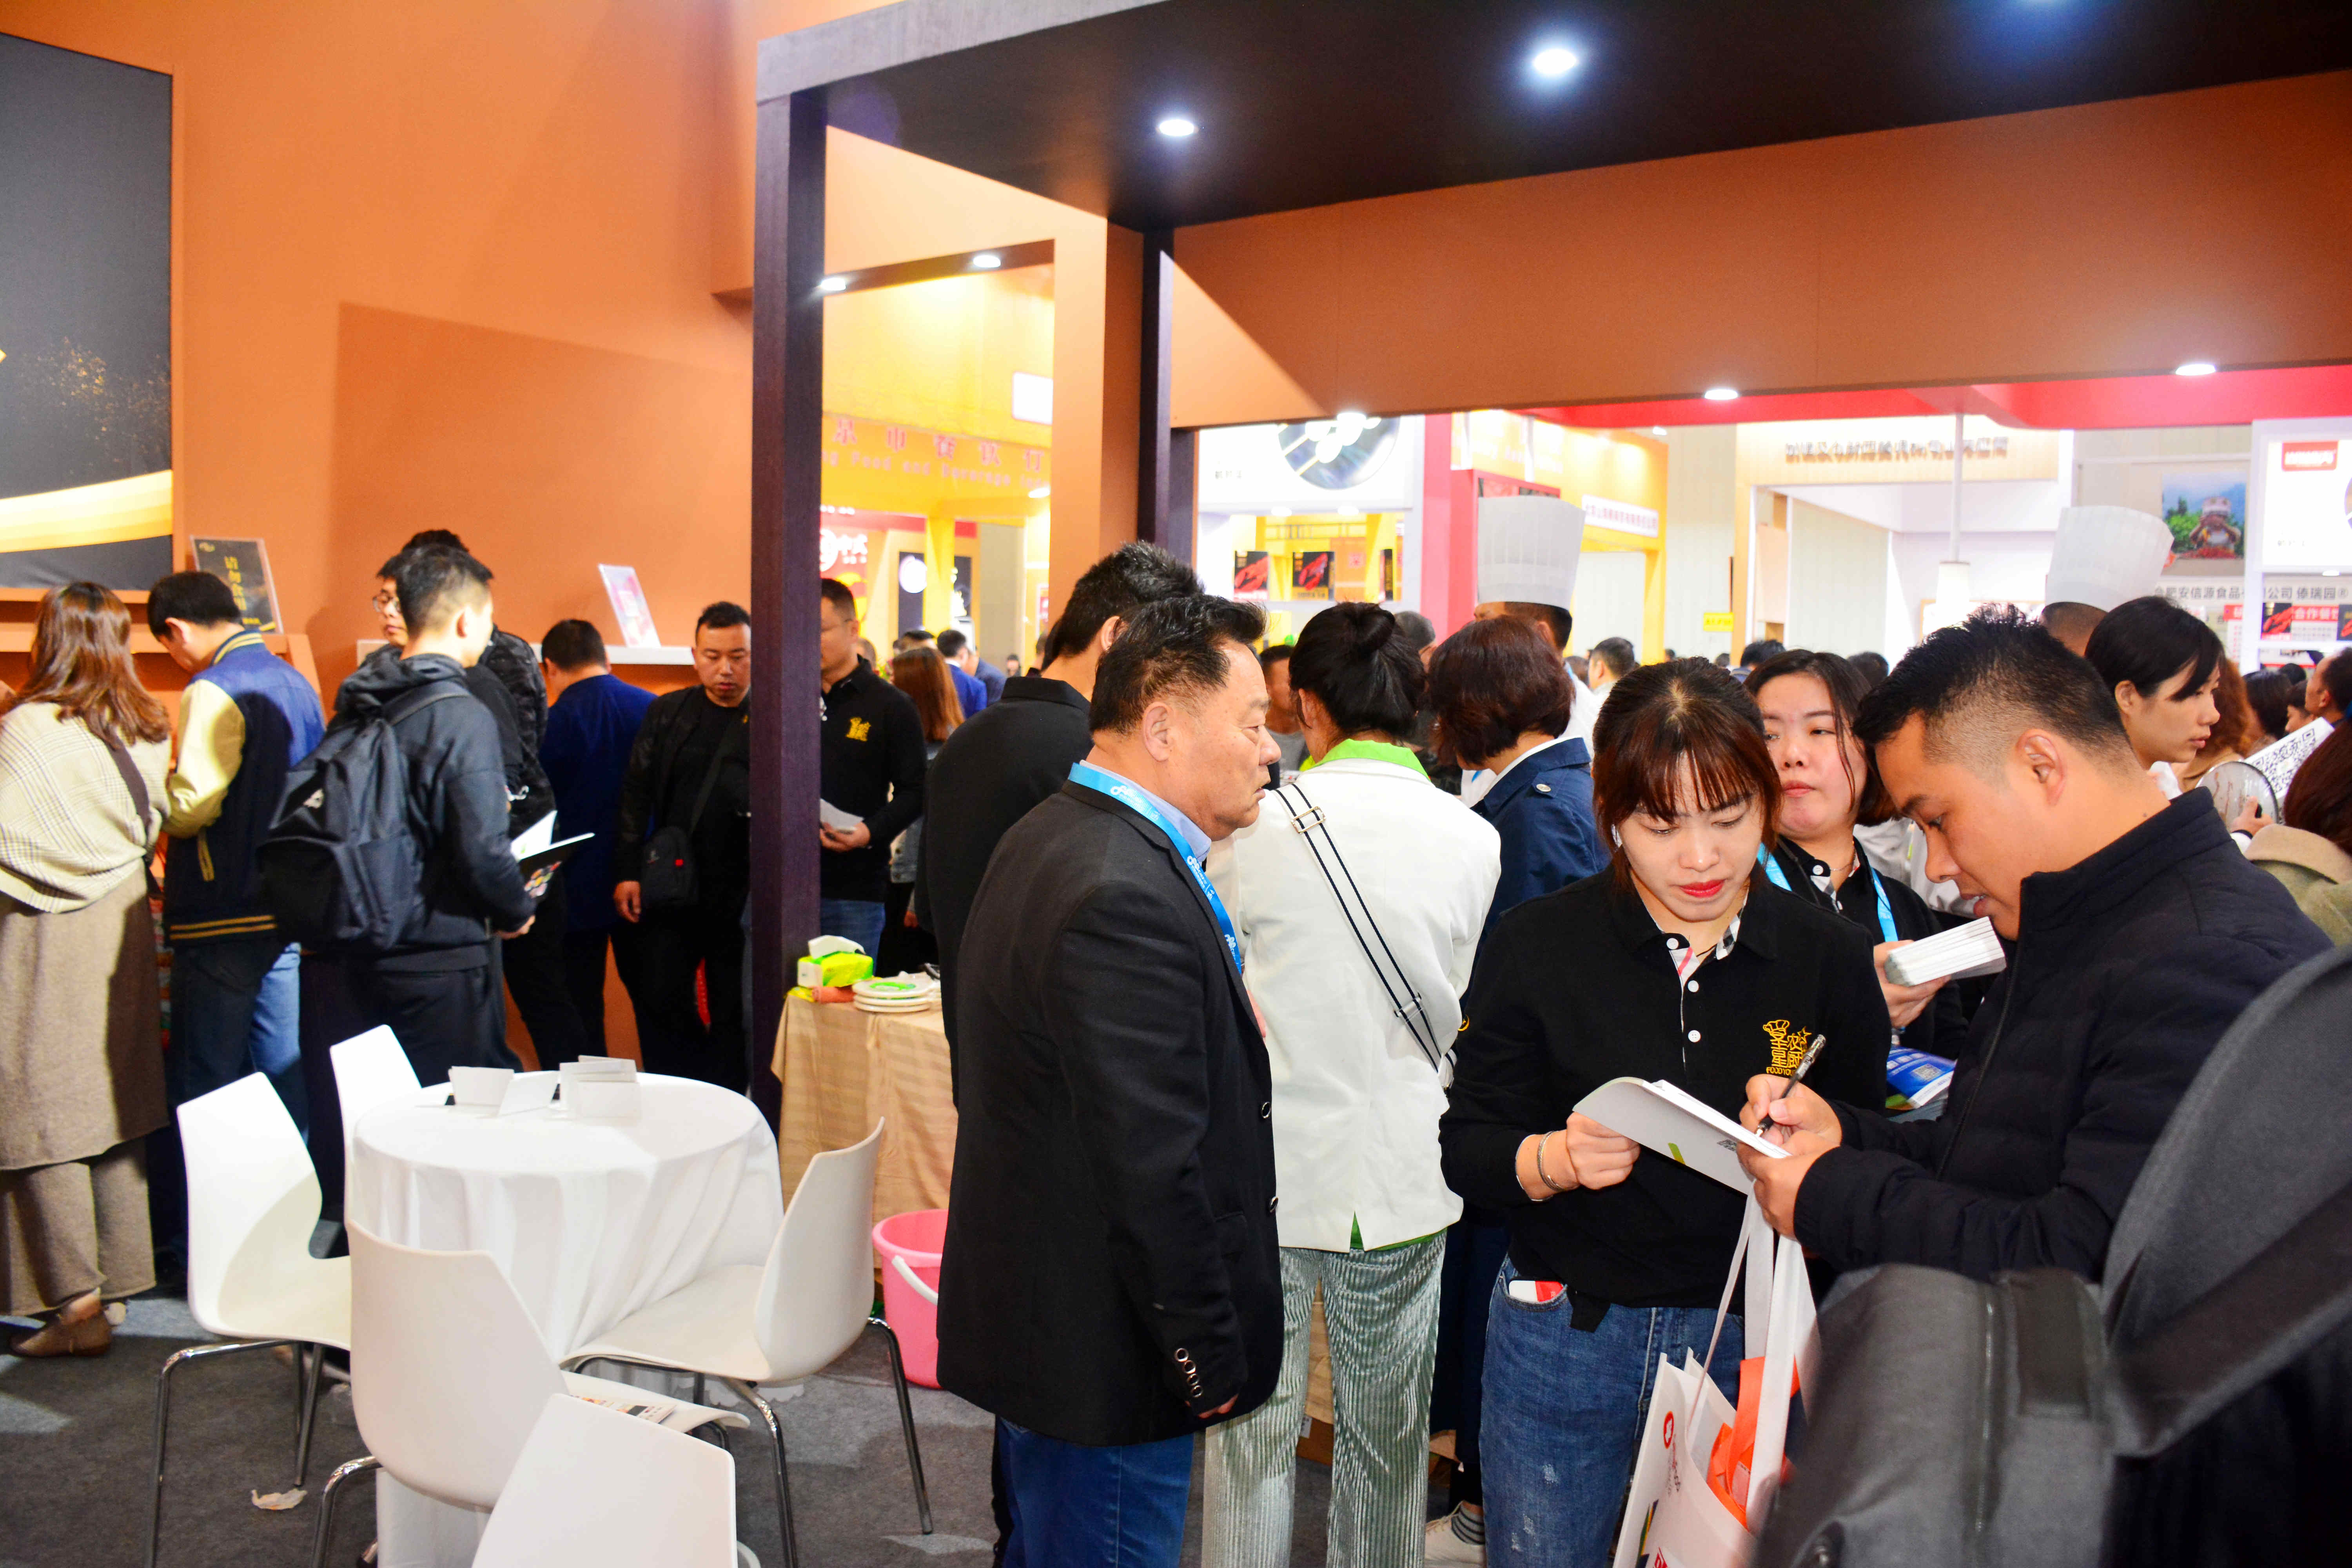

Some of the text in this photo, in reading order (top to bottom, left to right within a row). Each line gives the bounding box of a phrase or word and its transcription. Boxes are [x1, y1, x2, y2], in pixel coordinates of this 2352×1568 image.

[2154, 585, 2292, 600] 合肥安信源食品公司
